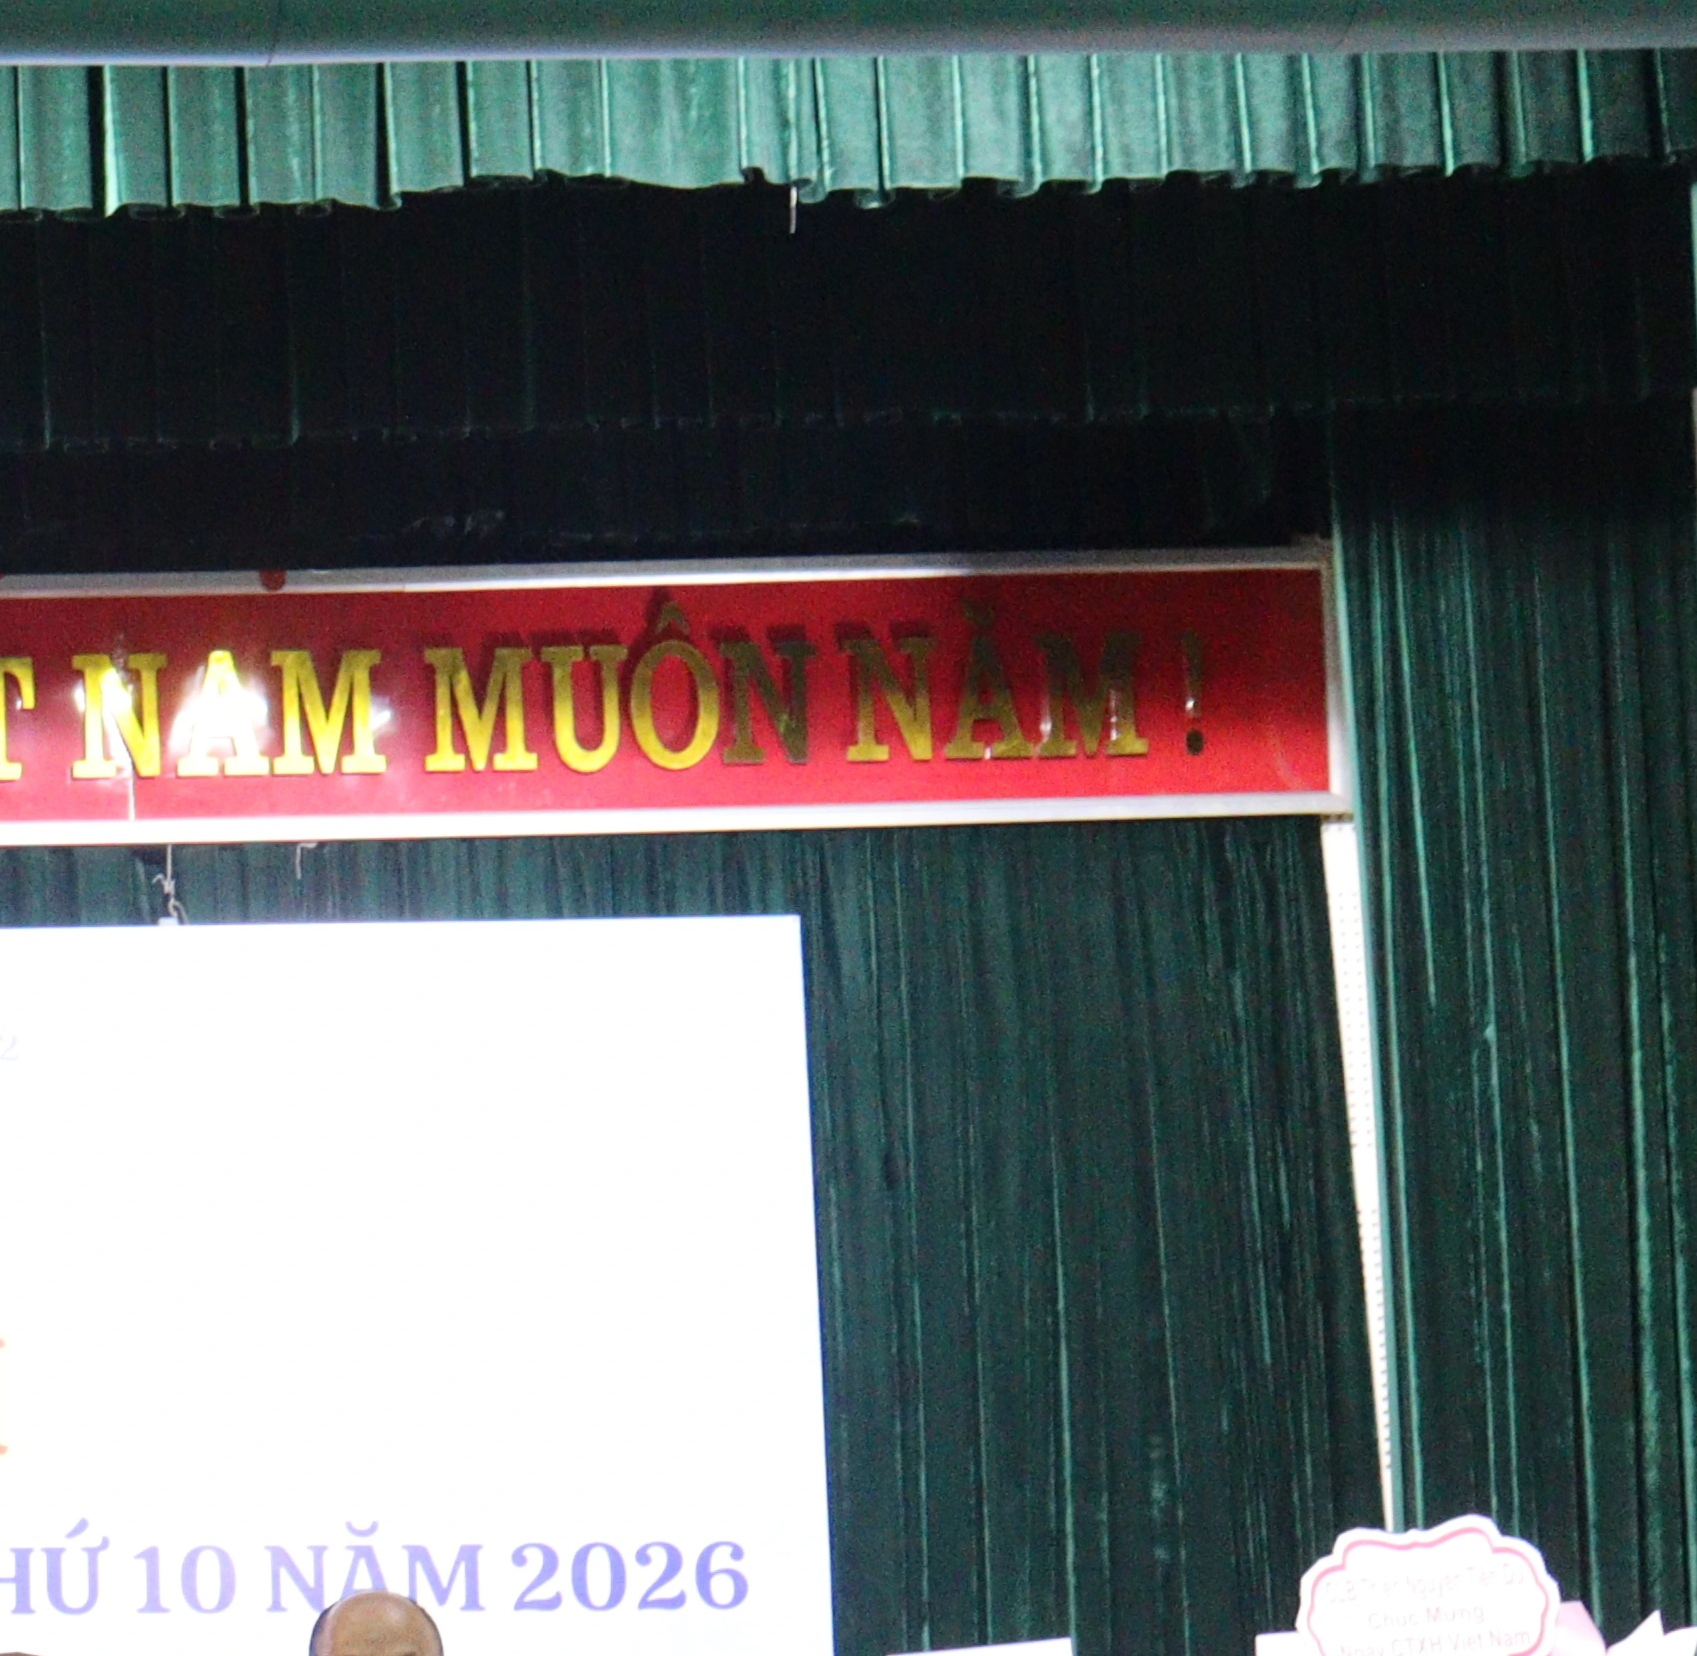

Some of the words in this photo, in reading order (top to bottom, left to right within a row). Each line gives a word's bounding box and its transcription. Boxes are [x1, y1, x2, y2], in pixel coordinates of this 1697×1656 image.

[71, 650, 387, 778] NAM
[424, 602, 813, 773] MUÔN
[845, 600, 1150, 762] NĂM
[0, 1034, 20, 1062] 2
[133, 1545, 237, 1614] 10
[264, 1520, 487, 1613] NĂM
[510, 1541, 750, 1612] 2026
